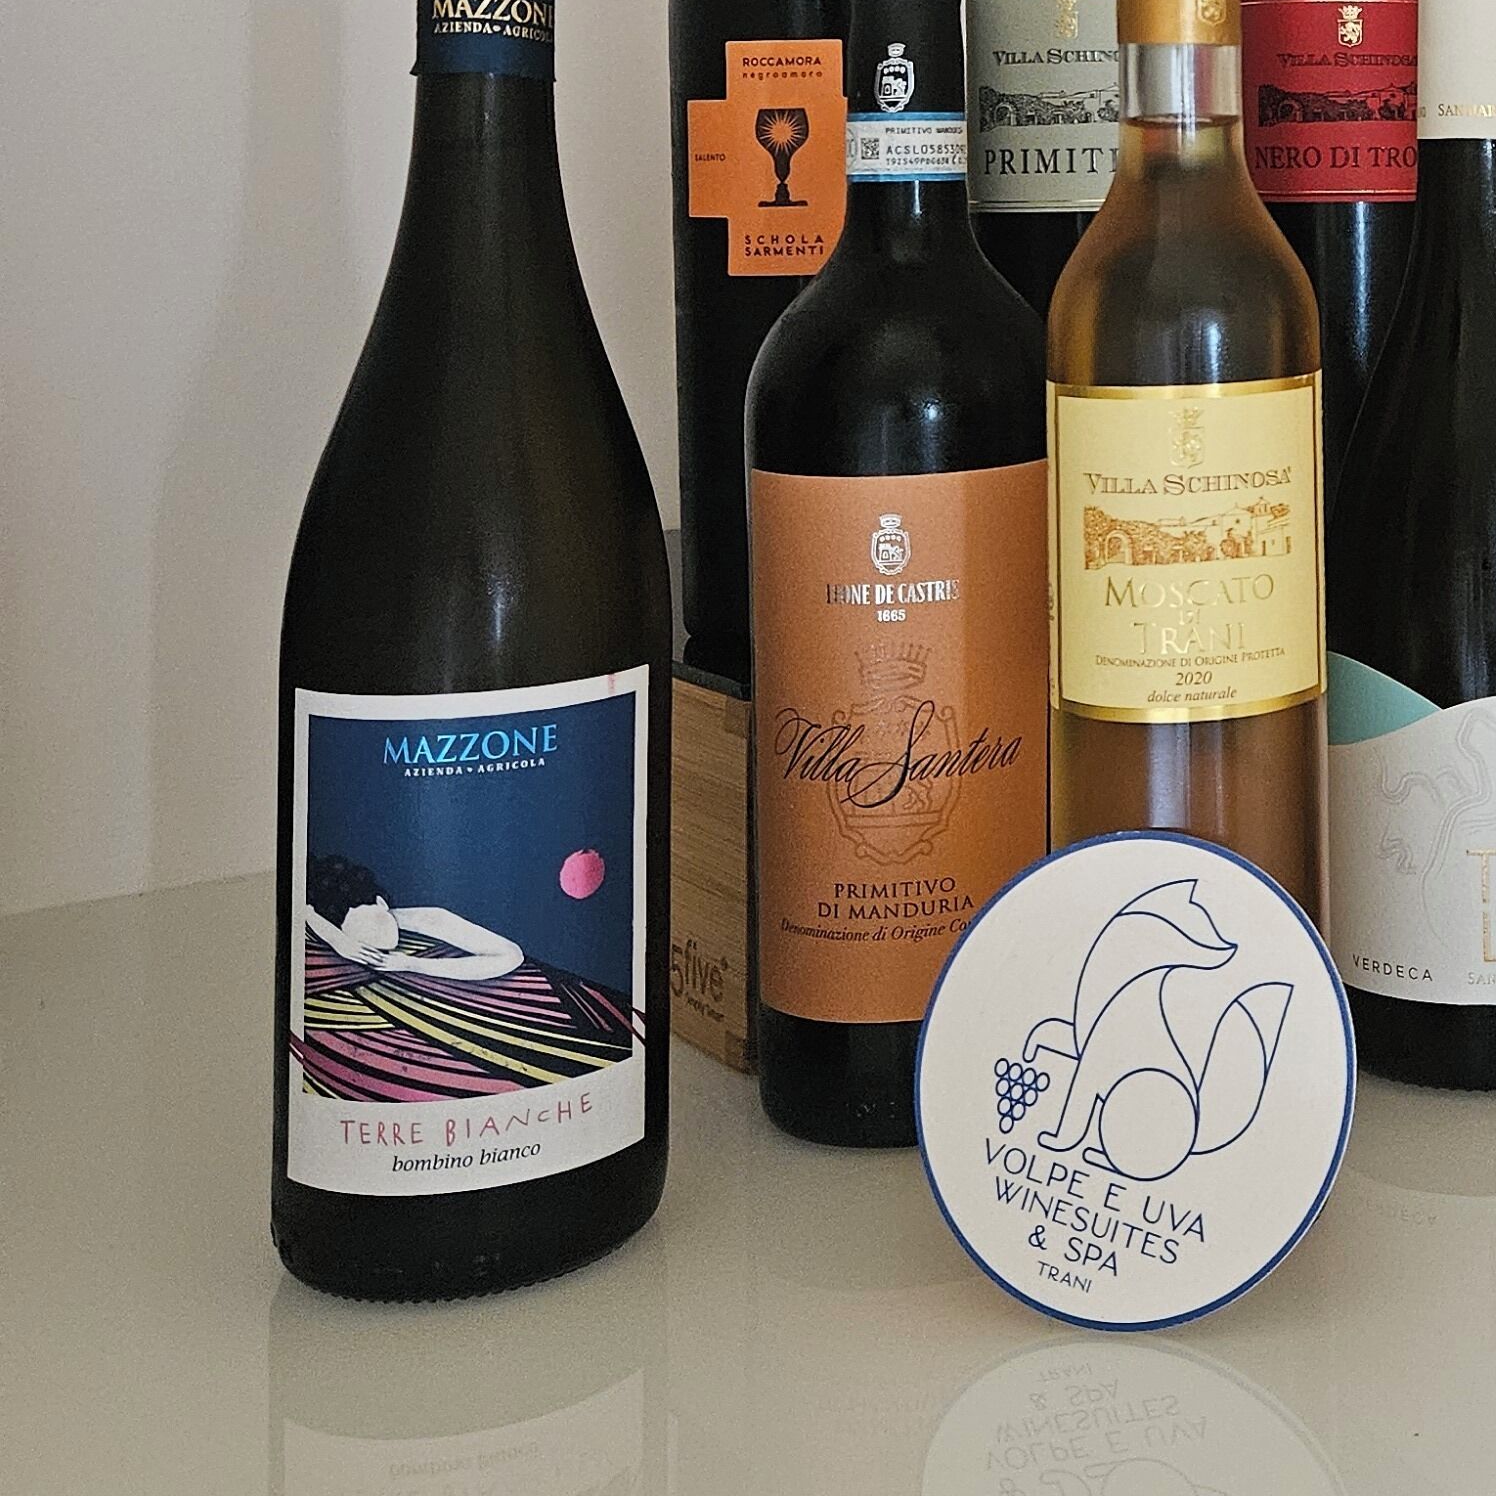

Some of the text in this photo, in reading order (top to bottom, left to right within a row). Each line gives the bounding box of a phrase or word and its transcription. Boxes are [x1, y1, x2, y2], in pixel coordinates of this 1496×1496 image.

[434, 21, 494, 34] AZIENDA
[742, 56, 822, 67] ROCCAMORA
[992, 50, 1044, 65] VILLA
[1276, 53, 1331, 68] VILLA
[1254, 146, 1322, 169] NERO
[1329, 146, 1360, 169] DI
[744, 234, 825, 246] SCHOLA
[744, 245, 825, 257] SARMENTI
[1083, 472, 1158, 495] VILLA
[875, 583, 895, 605] DE
[1104, 573, 1274, 608] MOSCATO
[1134, 621, 1245, 655] TRANI
[1095, 655, 1177, 668] DENOMINAZIONE
[1180, 657, 1192, 668] DI
[1194, 653, 1238, 667] ORIGINE
[1175, 670, 1213, 686] 2020
[1147, 686, 1238, 703] dolce naturale
[383, 723, 558, 766] MAZZONE
[774, 700, 1023, 809] Villa Santera
[404, 757, 546, 778] AZIENDA AGRICOLA
[833, 876, 957, 899] PRIMITIVO
[817, 895, 975, 920] DI MANDURIA
[780, 916, 870, 942] Denominazione
[872, 925, 888, 942] di
[891, 921, 946, 944] Origine
[1352, 953, 1433, 982] VERDECA
[339, 1091, 593, 1147] TERRE BIANCHE
[391, 1142, 542, 1173] bombino bianco
[984, 1137, 1206, 1244] VOLPE E UVA
[994, 1175, 1181, 1266] WINESUITES
[1028, 1224, 1120, 1278] & SPA
[1036, 1260, 1093, 1294] TRANI
